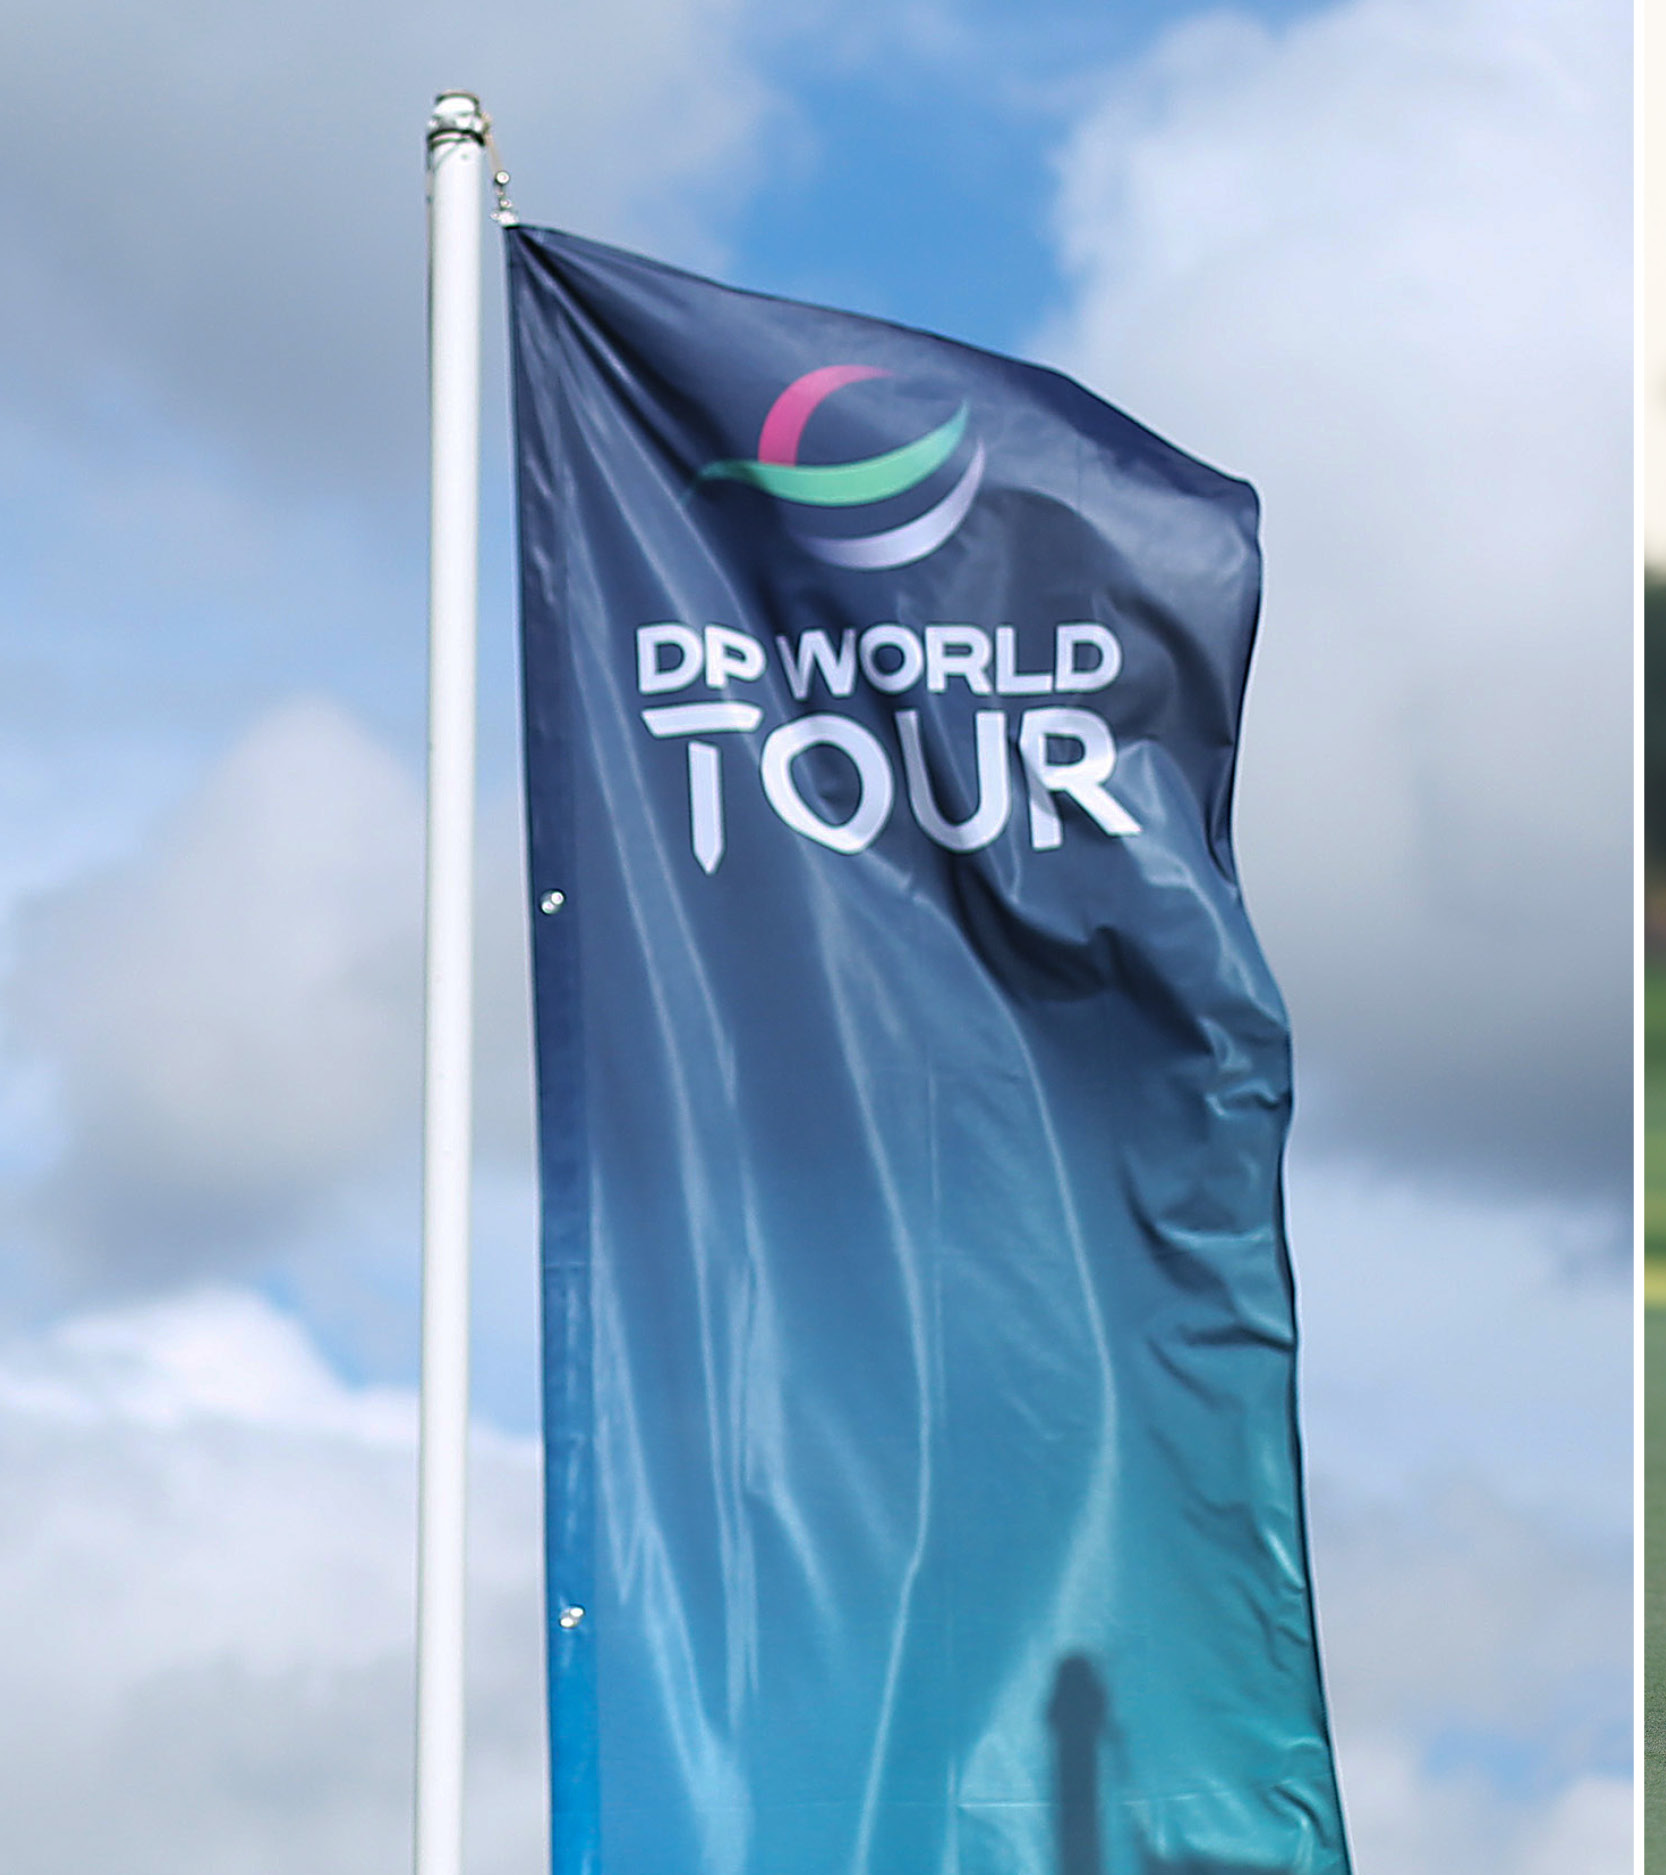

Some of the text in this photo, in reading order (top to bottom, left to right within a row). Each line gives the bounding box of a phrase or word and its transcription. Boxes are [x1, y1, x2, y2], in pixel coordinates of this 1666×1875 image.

[636, 622, 1122, 700] DP WORLD
[641, 702, 1143, 875] TOUR
